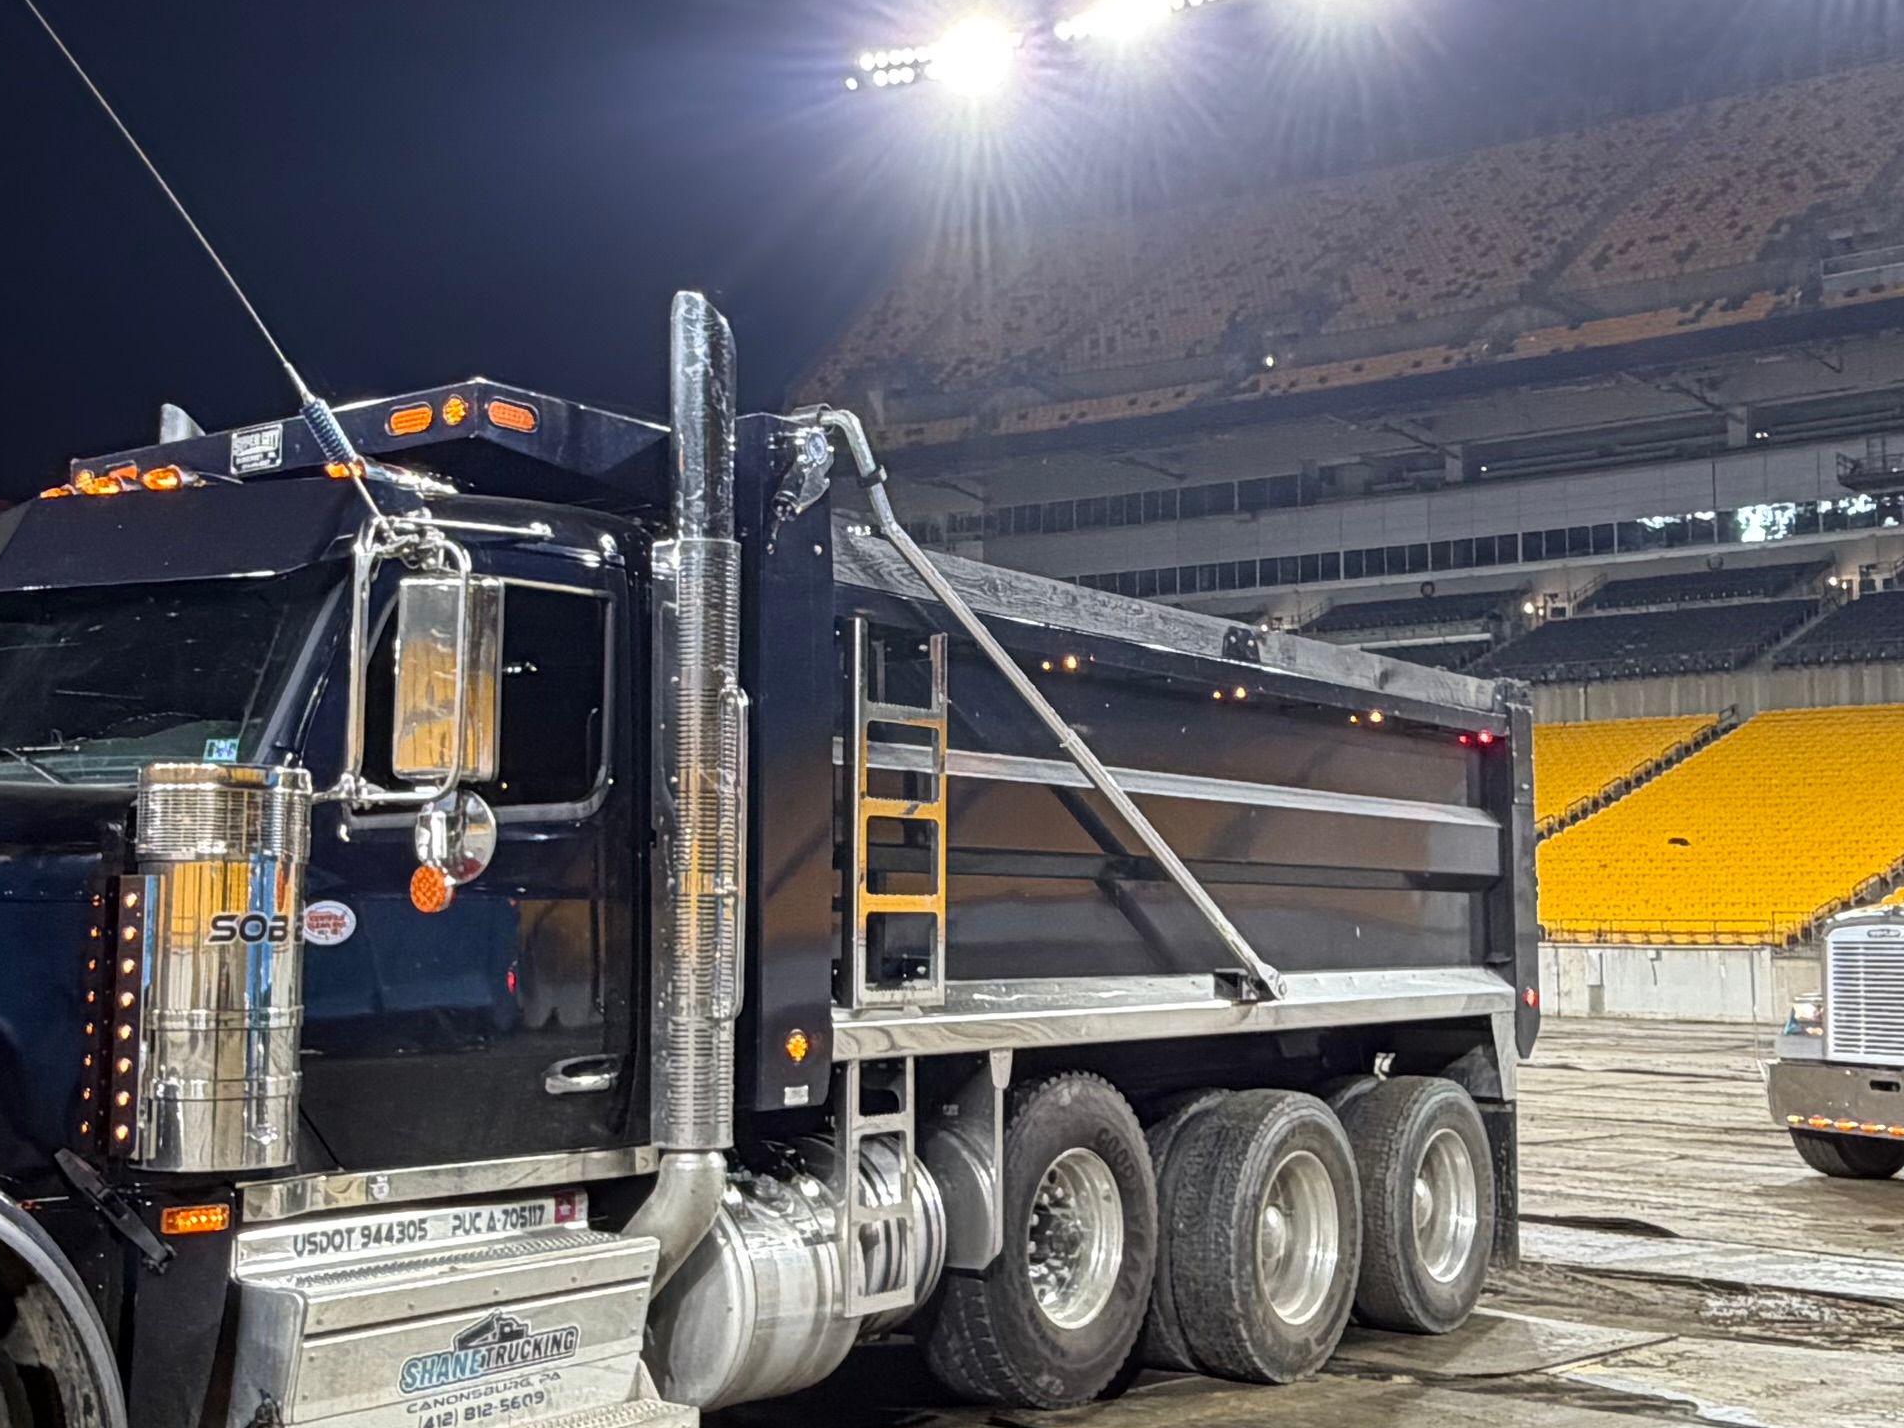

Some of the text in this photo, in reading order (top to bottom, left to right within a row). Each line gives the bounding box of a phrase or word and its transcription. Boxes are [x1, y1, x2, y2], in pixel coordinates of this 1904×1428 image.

[293, 1228, 356, 1258] USDOT
[360, 1218, 428, 1247] 944305
[451, 1211, 483, 1236] PUC
[403, 1330, 576, 1391] SHANE TRUCKING
[406, 1371, 561, 1415] CANONSBURG, PA
[463, 1390, 545, 1422] 812-5609
